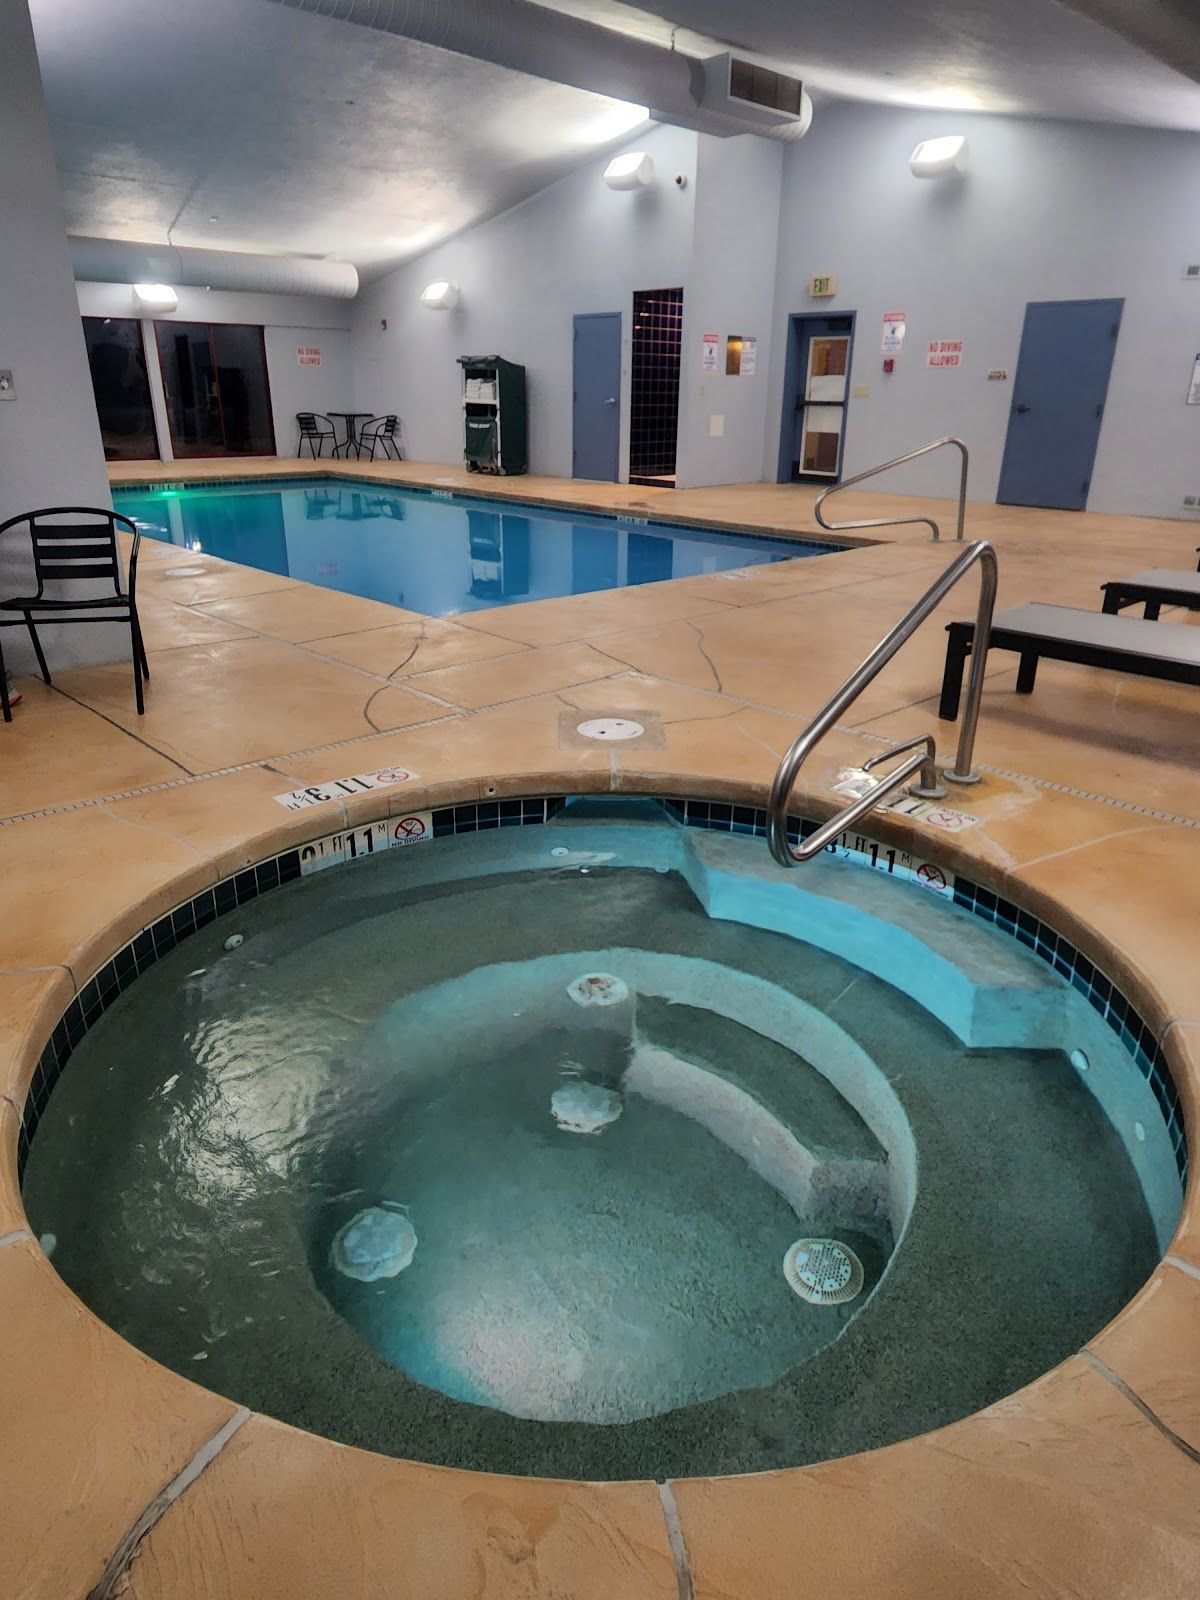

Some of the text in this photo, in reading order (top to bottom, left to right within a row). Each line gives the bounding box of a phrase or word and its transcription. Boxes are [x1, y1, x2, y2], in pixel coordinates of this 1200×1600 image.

[813, 277, 830, 292] EXIT
[306, 347, 321, 355] DIVING
[929, 341, 962, 352] NO DIVING
[299, 357, 321, 366] ALLOWED
[929, 354, 960, 366] ALLOWED
[332, 835, 342, 853] FT
[346, 827, 374, 858] 1.1
[378, 824, 386, 833] M
[404, 834, 430, 845] DIVING
[855, 836, 866, 852] FT
[869, 843, 896, 873] 1.1
[901, 852, 910, 863] M
